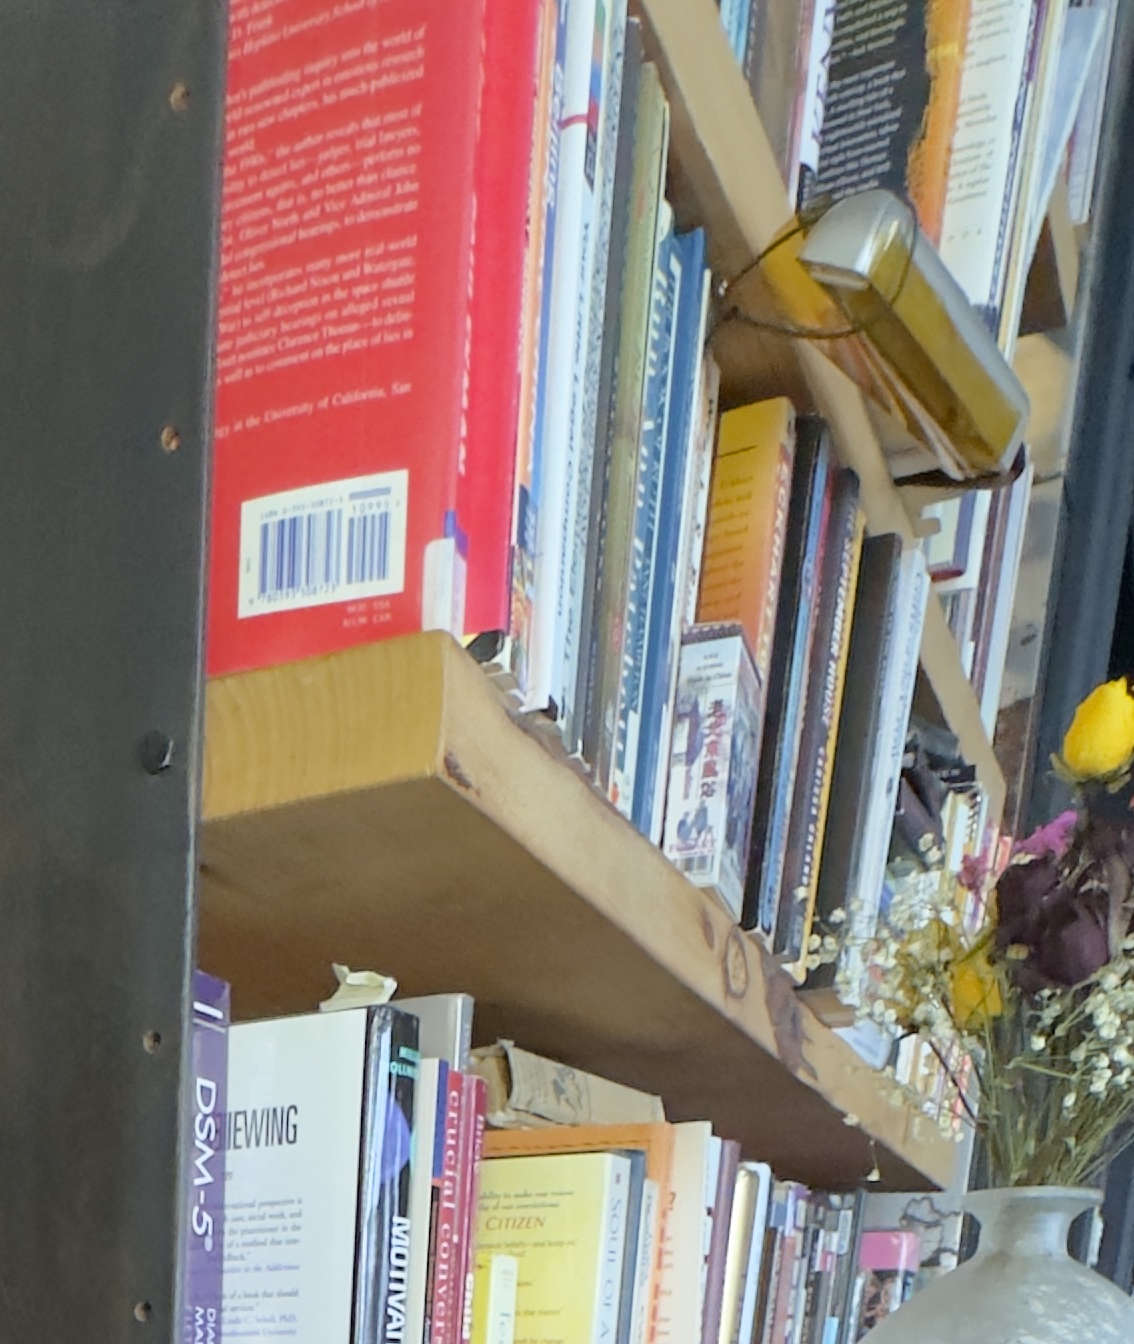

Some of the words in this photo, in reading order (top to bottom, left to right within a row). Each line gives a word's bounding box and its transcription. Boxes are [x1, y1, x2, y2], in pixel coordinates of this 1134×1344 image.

[382, 28, 411, 48] world
[381, 45, 425, 67] research
[293, 134, 324, 152] author
[326, 122, 359, 140] reveals
[381, 273, 415, 289] shuttle
[341, 296, 379, 317] alleged
[277, 332, 319, 350] Clarence
[264, 402, 314, 423] University
[228, 1105, 298, 1151] IEWING
[440, 1090, 463, 1208] crucial
[486, 1217, 546, 1231] CITIZEN
[606, 1198, 622, 1263] SOUL
[602, 1279, 613, 1310] OF
[462, 1272, 473, 1339] Child
[600, 1321, 609, 1339] A
